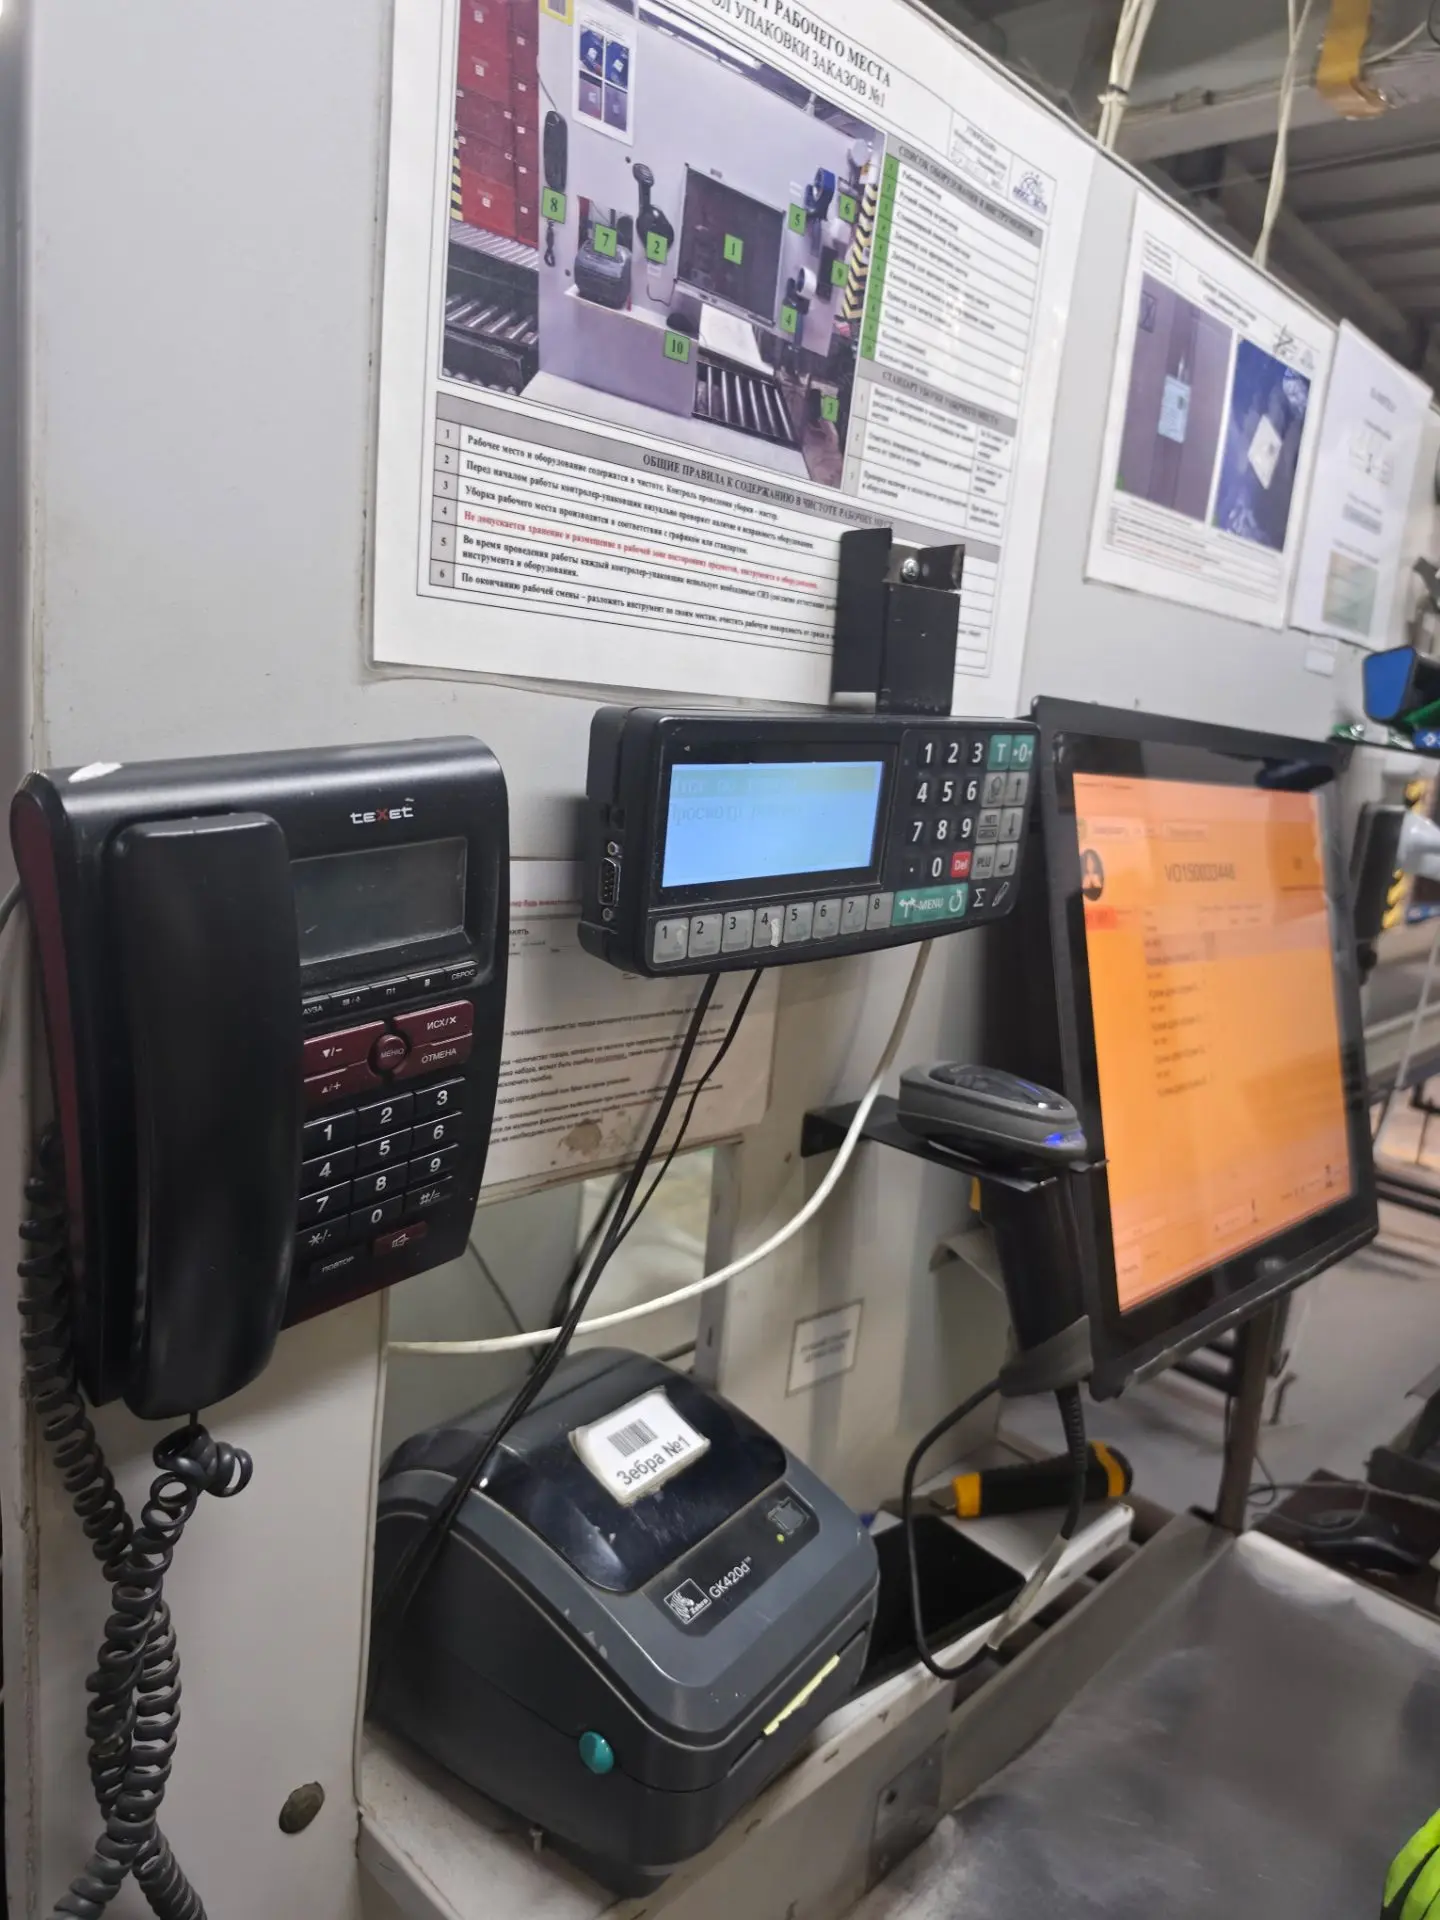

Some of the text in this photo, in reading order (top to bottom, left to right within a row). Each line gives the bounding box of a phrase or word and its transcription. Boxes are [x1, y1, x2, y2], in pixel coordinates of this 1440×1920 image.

[735, 1, 886, 108] УПАКОВКИ ЗАКАЗОВ №1
[774, 0, 891, 87] РАБОЧЕГО МЕСТА
[446, 429, 450, 439] 1
[444, 454, 450, 464] 2
[467, 434, 500, 451] Рабочее
[502, 445, 525, 457] место
[527, 451, 532, 459] и
[534, 453, 587, 472] оборудование
[666, 484, 697, 500] Контроль
[443, 481, 448, 490] 3
[466, 459, 491, 474] Перед
[493, 468, 528, 482] началом
[529, 477, 559, 489] работы
[643, 454, 680, 474] ОБЩИЕ
[682, 464, 725, 486] ПРАВИЛА
[727, 476, 733, 488] К
[734, 477, 795, 504] СОДЕРЖАНИЮ
[803, 499, 837, 517] ЧИСТОТЕ
[442, 506, 448, 516] 4
[465, 484, 496, 500] Уборка
[497, 494, 533, 508] рабочего
[535, 502, 557, 513] места
[440, 536, 447, 547] 5
[464, 510, 476, 521] Не
[476, 515, 526, 532] допускается
[528, 525, 564, 539] хранение
[572, 534, 617, 550] размещение
[462, 550, 515, 566] инструмента
[523, 560, 579, 577] оборудования.
[463, 534, 474, 545] Во
[476, 538, 501, 550] время
[503, 543, 549, 559] проведения
[551, 552, 579, 564] работы
[580, 558, 610, 570] каждый
[439, 569, 445, 579] 6
[461, 572, 474, 583] По
[475, 576, 521, 591] окончанию
[522, 583, 554, 596] рабочей
[555, 589, 580, 600] смены
[587, 594, 626, 608] разложить
[925, 742, 933, 764] 1
[947, 742, 959, 764] 2
[972, 742, 984, 764] 3
[917, 780, 977, 803] 4 5 6
[912, 820, 923, 842] 7
[936, 819, 948, 840] 8
[961, 817, 972, 838] 9
[931, 857, 943, 878] 0
[662, 898, 880, 939] 1 2 3 4 5 6 7 8
[421, 1047, 457, 1065] ОТМЕНА
[323, 1090, 448, 1141] 1 2 3
[319, 1124, 444, 1178] 4 5 6
[316, 1157, 441, 1213] 7 8 9
[371, 1208, 383, 1224] 0
[616, 1434, 692, 1486] Зебра №1
[689, 1598, 709, 1615] Zebra
